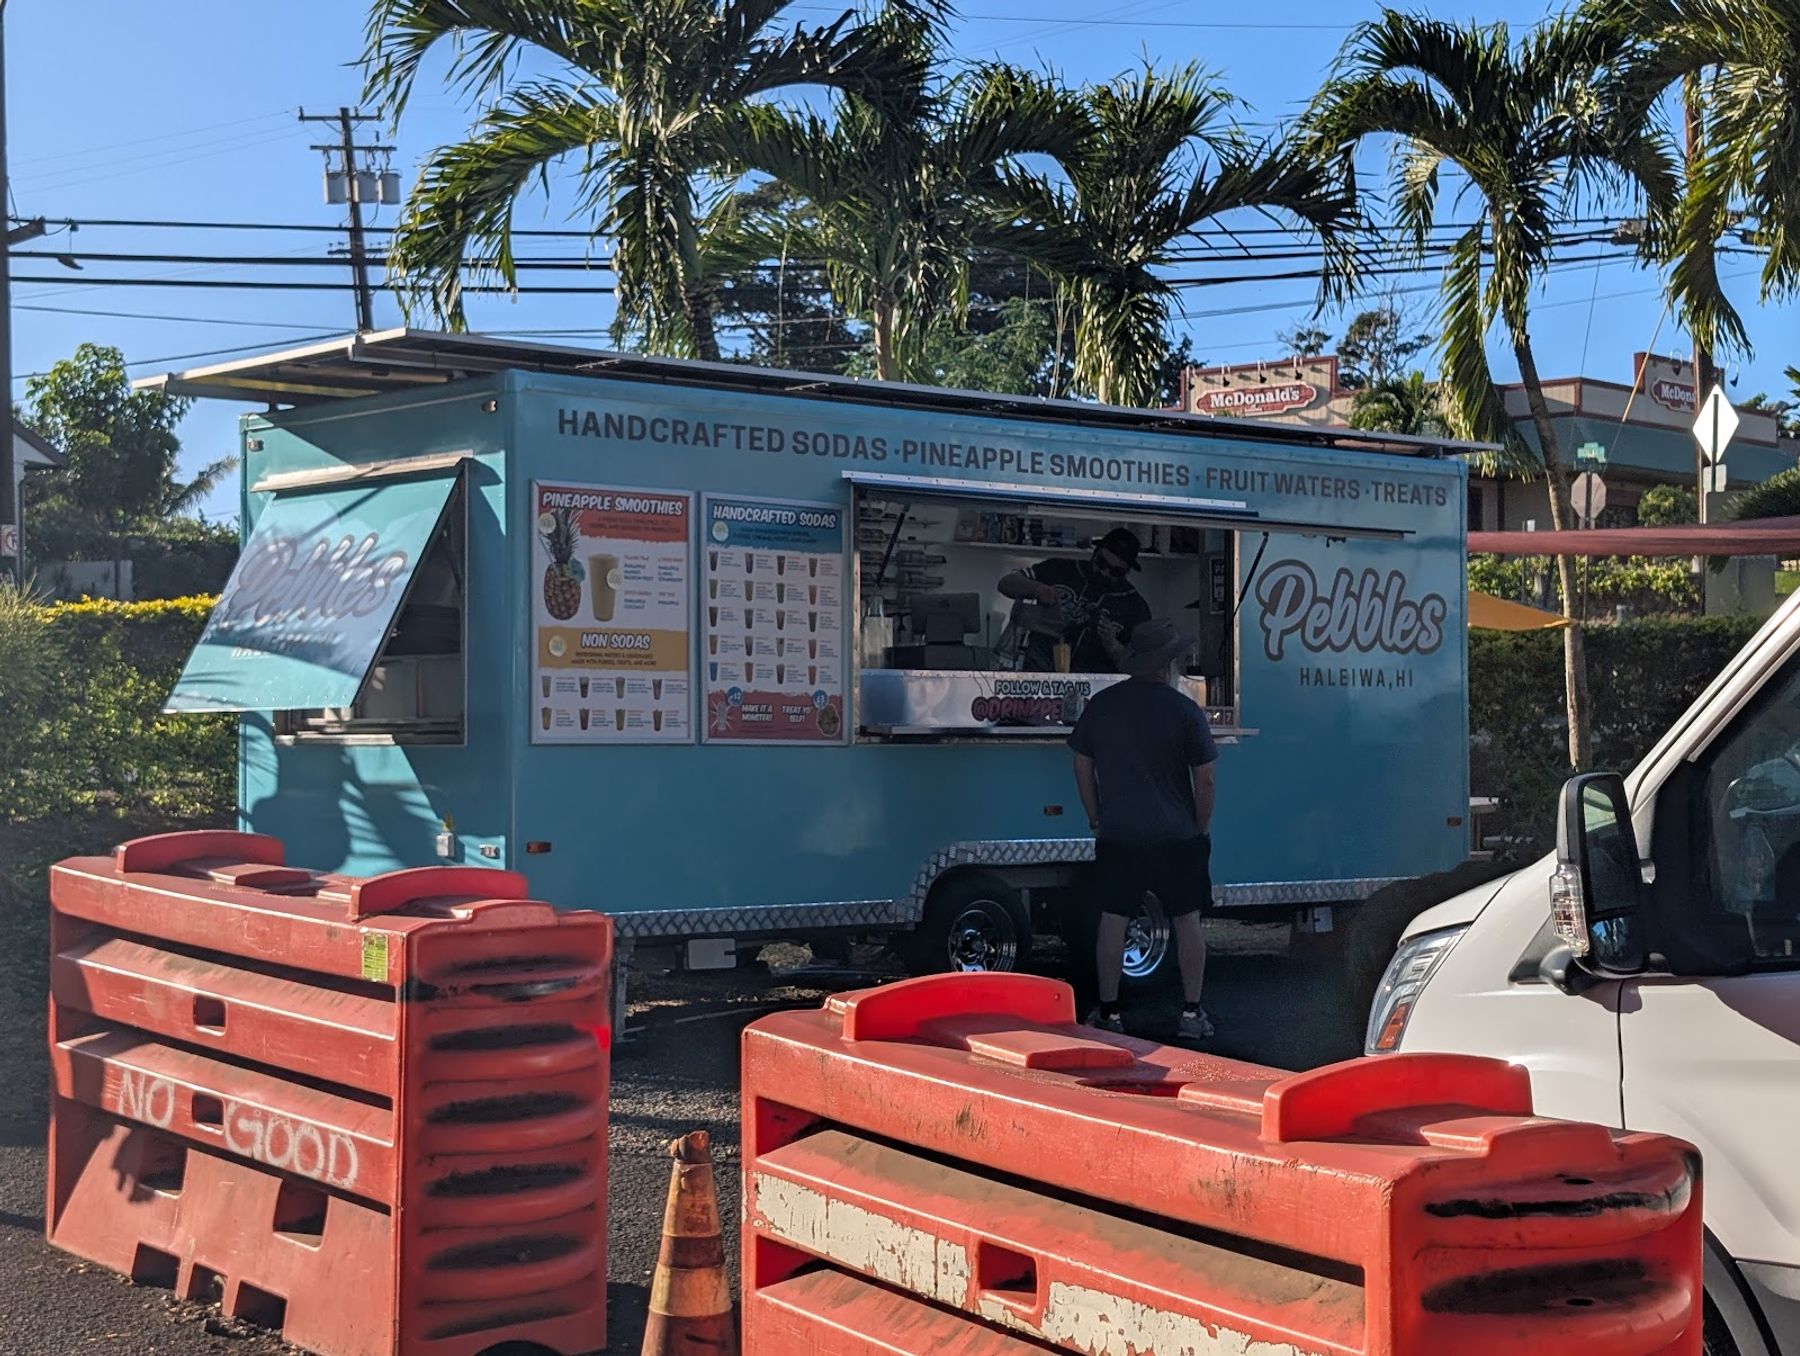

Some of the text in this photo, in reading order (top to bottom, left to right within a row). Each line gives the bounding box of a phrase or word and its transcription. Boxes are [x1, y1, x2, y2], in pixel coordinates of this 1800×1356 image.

[1210, 386, 1300, 409] McDonald's
[558, 408, 1447, 507] HANDCRAFTED SODAS PINEAPPLE SMOOTHIES FRUIT WATERS TREATS
[542, 492, 684, 516] PINEAPPLE SMOOTHIES
[713, 505, 837, 528] HANDCRAFTED SODAS
[1255, 559, 1447, 662] Pebbles
[581, 632, 652, 650] NON SODAS
[994, 680, 1040, 696] FOLLOW
[1041, 680, 1051, 696] &
[118, 1069, 359, 1189] NO GOOD
